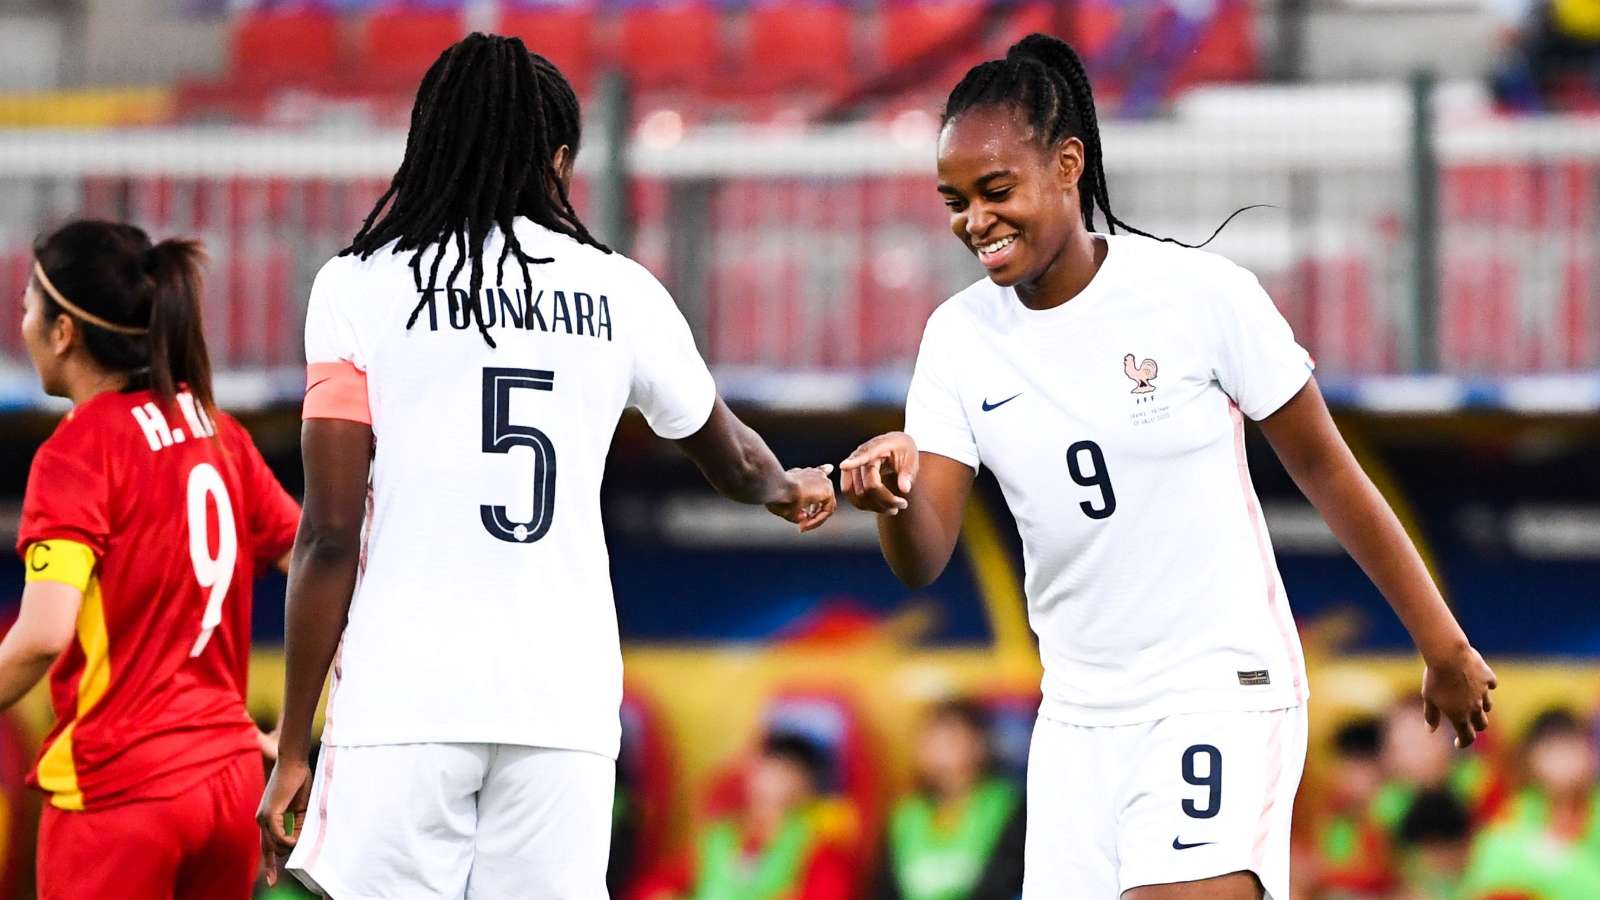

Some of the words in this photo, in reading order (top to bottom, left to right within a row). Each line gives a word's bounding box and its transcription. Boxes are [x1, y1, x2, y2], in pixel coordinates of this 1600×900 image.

[417, 287, 612, 342] TOUNKARA
[131, 402, 186, 452] H.
[480, 367, 556, 544] 5
[1066, 440, 1116, 519] 9
[31, 543, 51, 572] C
[187, 463, 238, 658] 9
[1181, 744, 1222, 819] 9
